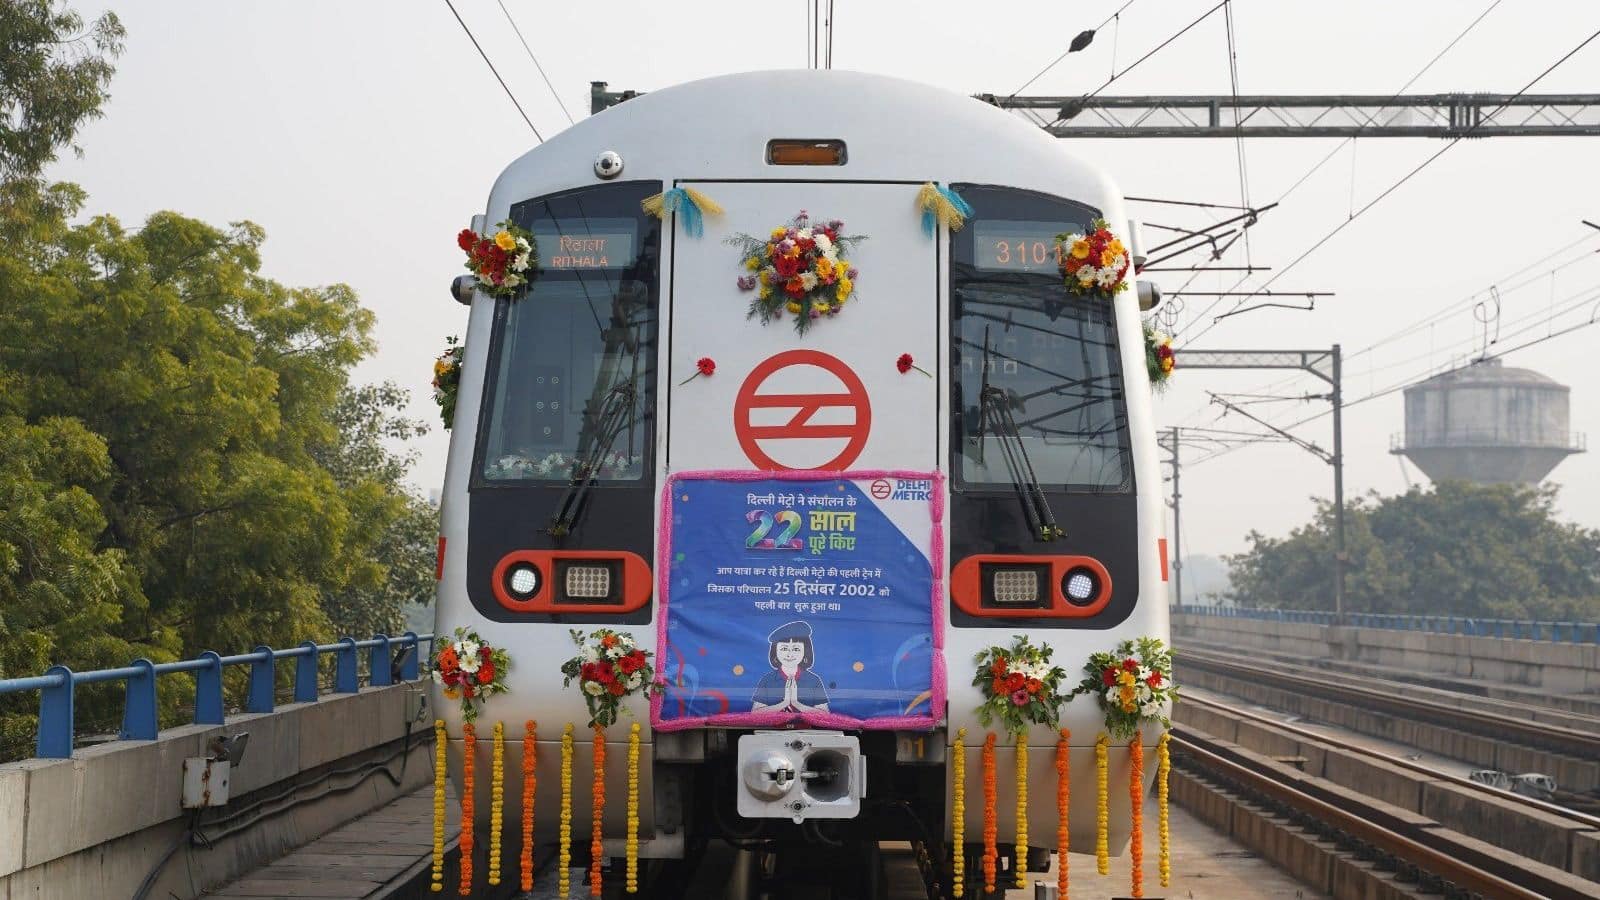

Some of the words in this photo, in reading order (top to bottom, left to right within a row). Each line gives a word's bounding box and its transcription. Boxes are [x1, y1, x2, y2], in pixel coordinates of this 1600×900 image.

[552, 256, 608, 267] RITHALA
[897, 480, 931, 490] DELHI
[746, 493, 775, 505] दिल्ली
[778, 493, 795, 508] मेट्रो
[797, 494, 805, 505] ने
[807, 495, 844, 506] संचालन
[846, 495, 857, 506] के
[745, 509, 803, 550] 22
[809, 510, 857, 531] साल
[808, 533, 826, 555] पूरे
[829, 533, 856, 551] किए
[716, 567, 732, 575] आप
[734, 567, 751, 576] यात्रा
[753, 568, 766, 576] कर
[767, 566, 778, 577] रहे
[787, 566, 809, 577] दिल्ली
[811, 567, 825, 579] मेट्रो
[827, 567, 838, 577] की
[840, 568, 860, 578] पहली
[862, 568, 873, 579] ट्रेन
[874, 568, 882, 578] में
[707, 584, 735, 593] जिसका
[737, 584, 772, 594] परिचालन
[774, 582, 790, 595] 25
[794, 580, 836, 596] दिसंबर
[839, 584, 876, 596] 2002
[879, 587, 890, 597] को
[754, 600, 776, 610] पहली
[777, 602, 791, 610] बार
[811, 603, 826, 614] हुआ
